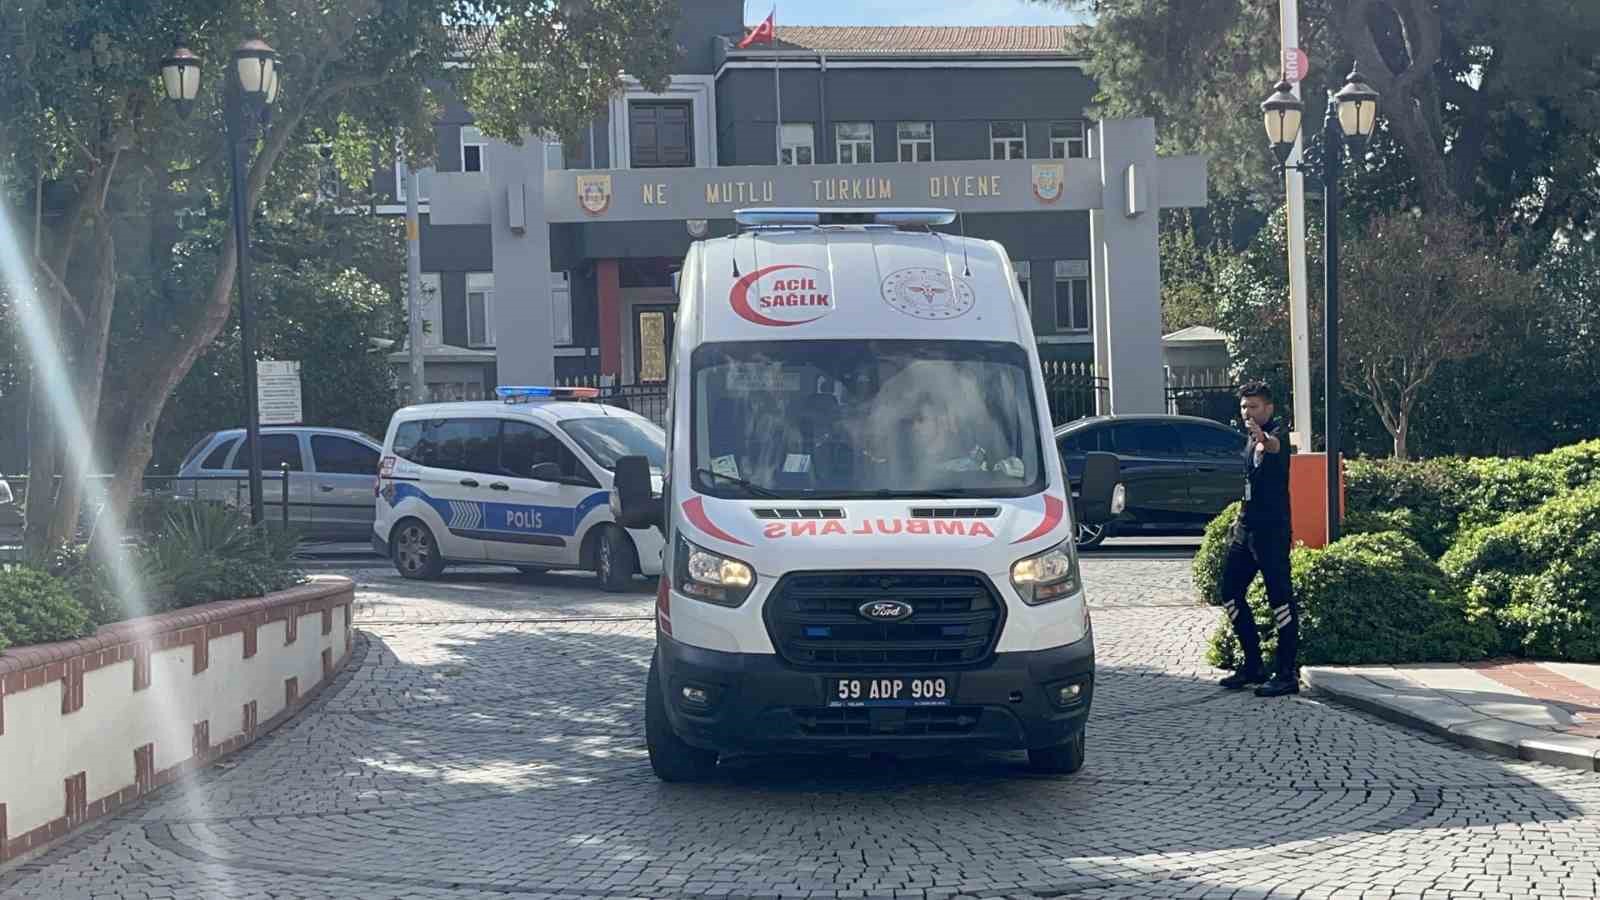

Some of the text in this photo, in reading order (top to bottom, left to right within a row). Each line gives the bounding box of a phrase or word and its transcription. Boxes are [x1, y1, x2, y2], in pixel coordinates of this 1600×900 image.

[1285, 51, 1299, 80] DUR
[642, 183, 668, 205] NE
[705, 179, 774, 204] MUTLU
[773, 277, 817, 291] ACİL
[759, 292, 830, 308] SAĞLIK
[505, 508, 543, 529] POLİS
[870, 602, 902, 617] Ford
[838, 678, 946, 699] 59 ADP 909
